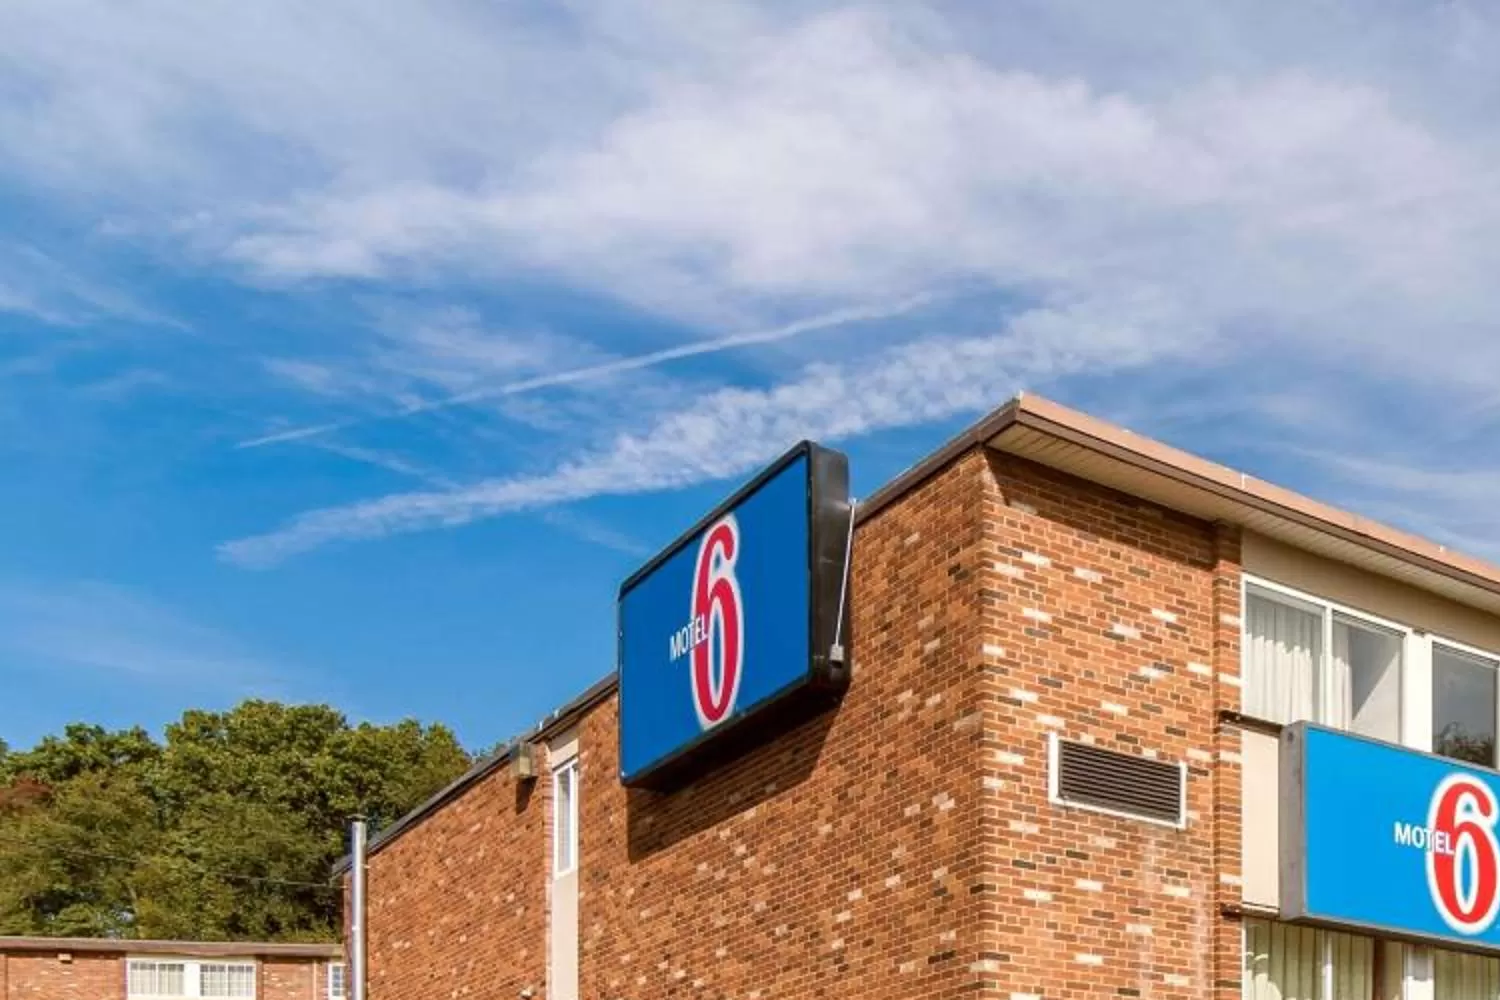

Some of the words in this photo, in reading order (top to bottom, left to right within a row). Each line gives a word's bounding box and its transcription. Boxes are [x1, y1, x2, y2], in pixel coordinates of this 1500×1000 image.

[669, 614, 710, 662] MOTEL
[691, 513, 743, 730] 6
[1394, 822, 1455, 856] MOTEL
